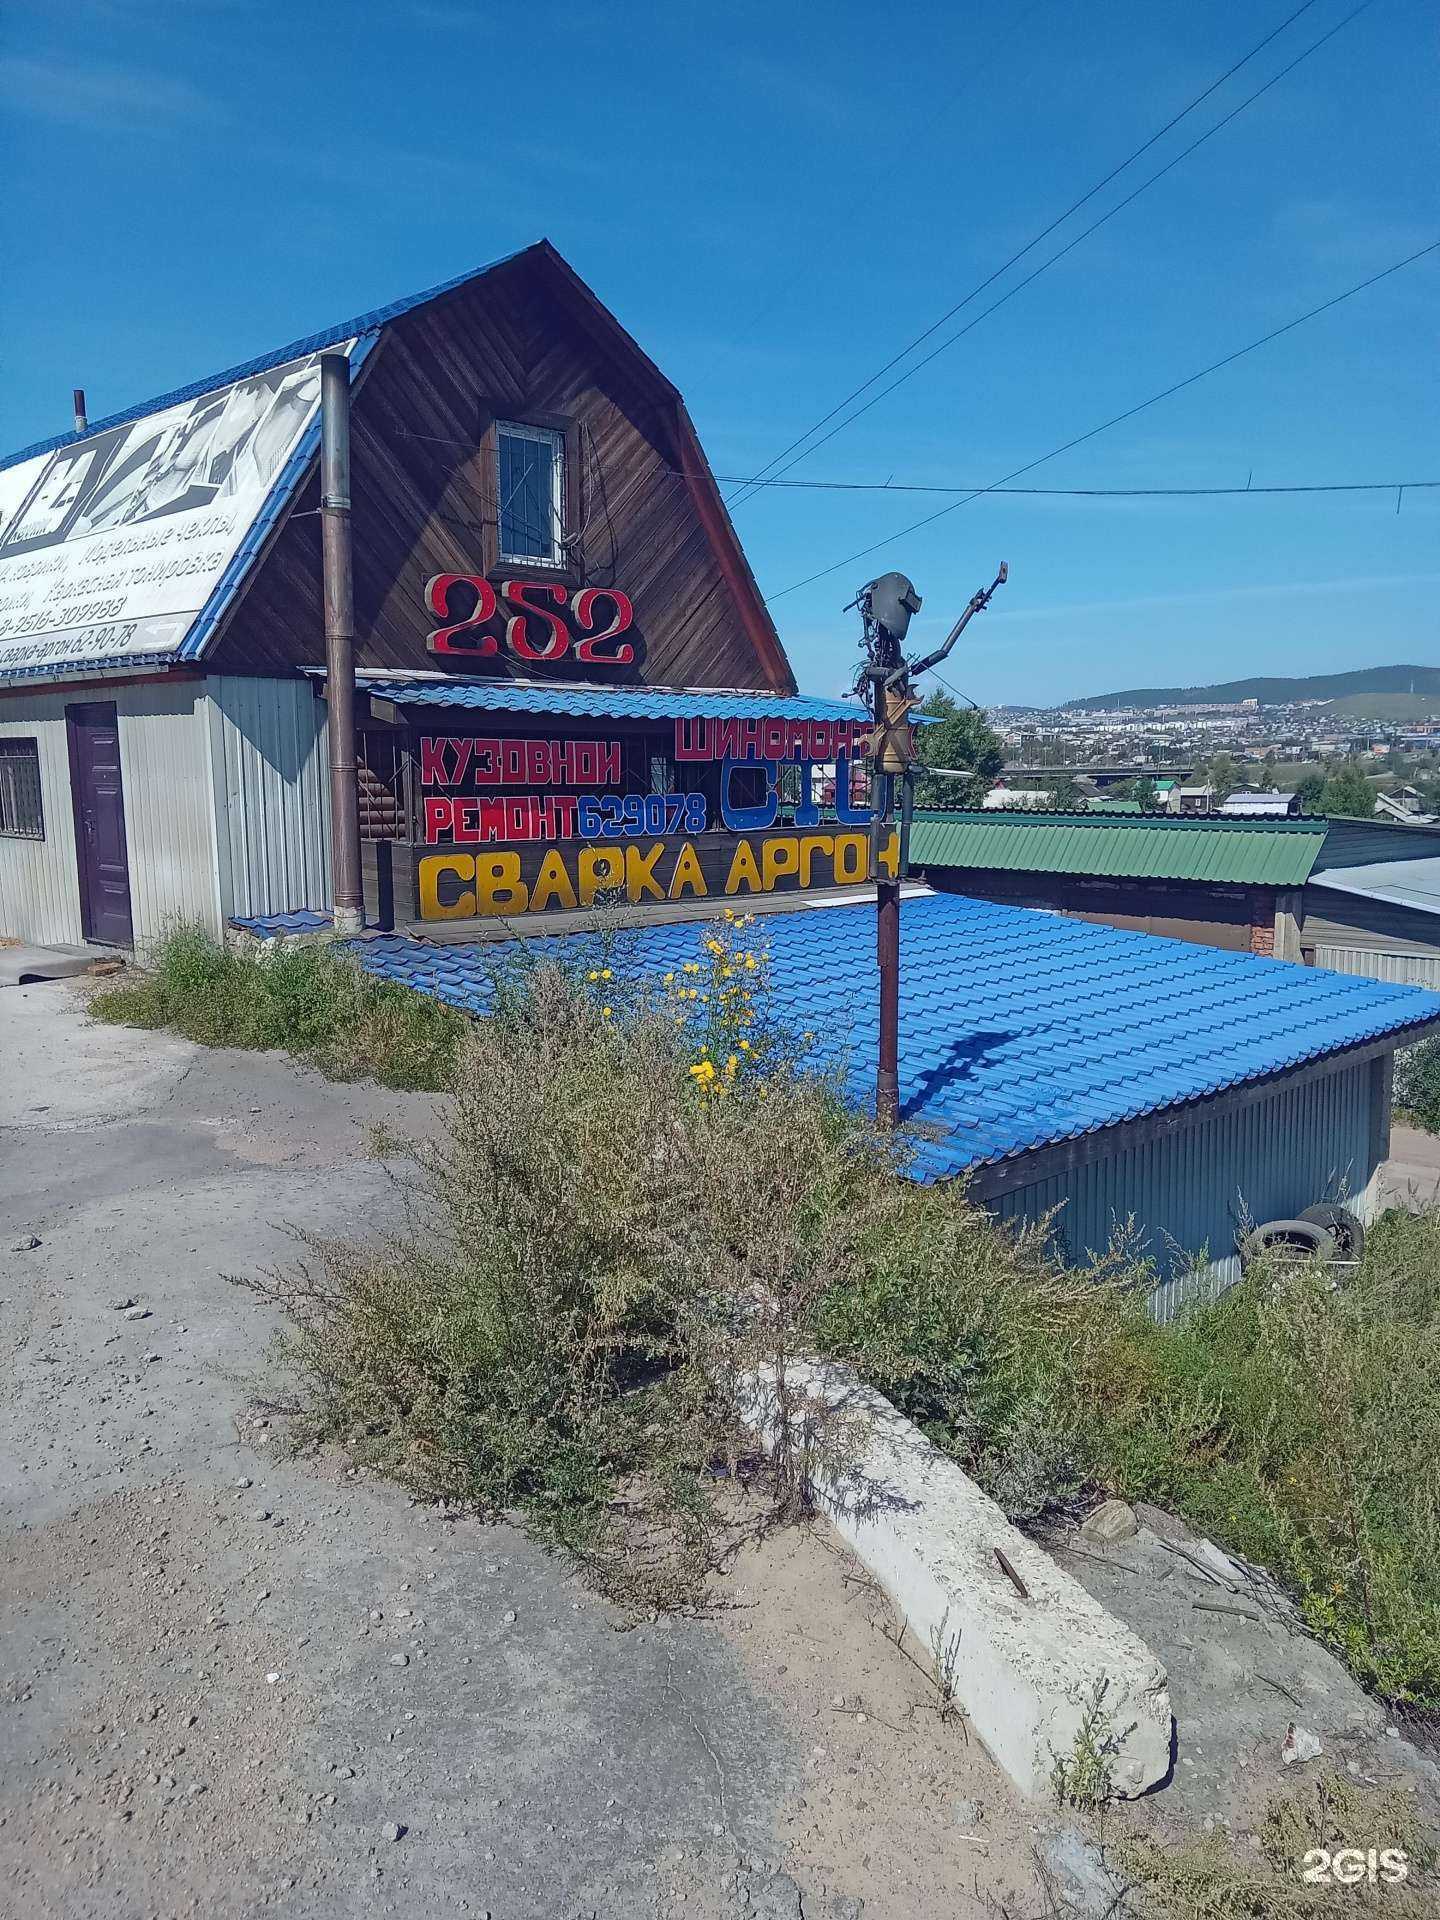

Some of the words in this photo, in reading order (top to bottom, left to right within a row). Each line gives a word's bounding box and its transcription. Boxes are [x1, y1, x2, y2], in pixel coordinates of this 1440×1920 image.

[126, 552, 223, 587] тонировка
[71, 623, 137, 654] 62-90-78
[424, 573, 634, 663] 252
[675, 717, 918, 761] ШИНОМОНТ
[424, 796, 578, 845] РЕМОНТ
[577, 792, 707, 840] 629078
[419, 843, 707, 919] СВАРКА
